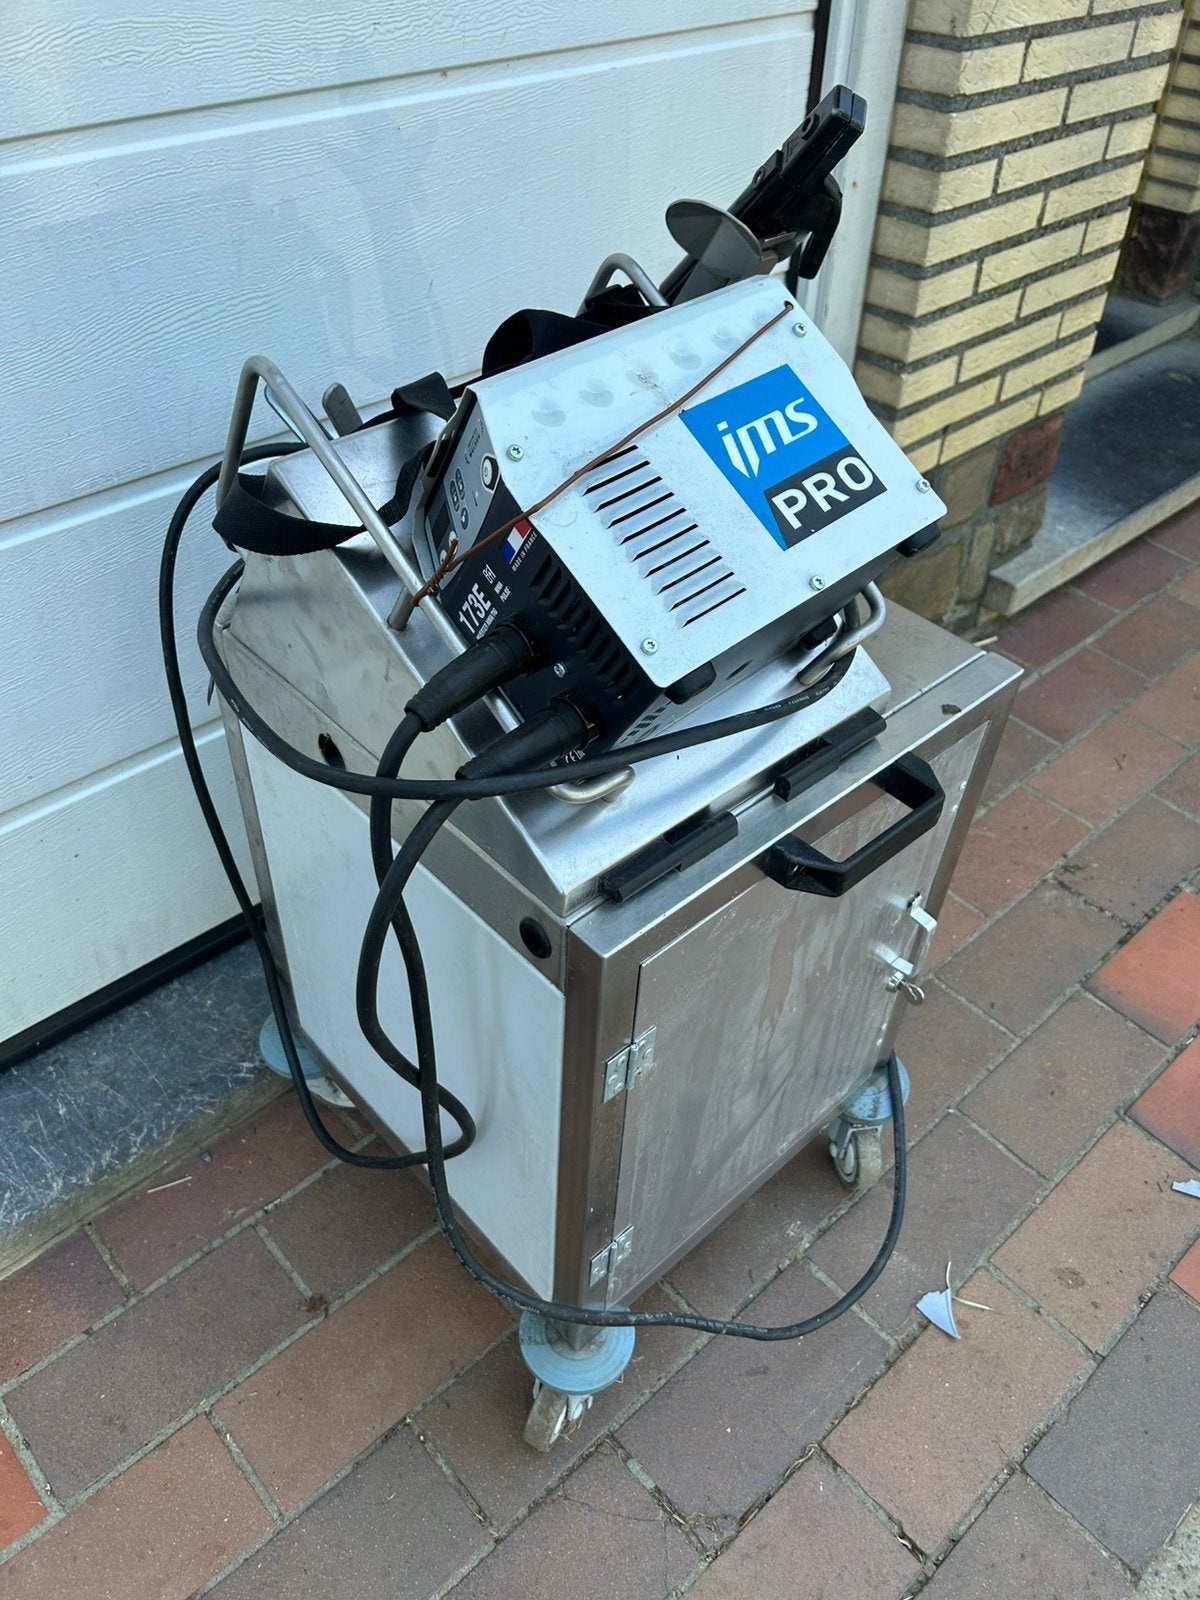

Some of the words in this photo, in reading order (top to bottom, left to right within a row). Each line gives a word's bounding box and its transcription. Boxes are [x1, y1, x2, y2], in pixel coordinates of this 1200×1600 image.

[716, 397, 819, 479] ims
[771, 456, 874, 530] PRO
[511, 556, 522, 572] MADE
[523, 531, 538, 553] FRANCE
[458, 582, 492, 634] 173E
[499, 586, 511, 603] PULSE
